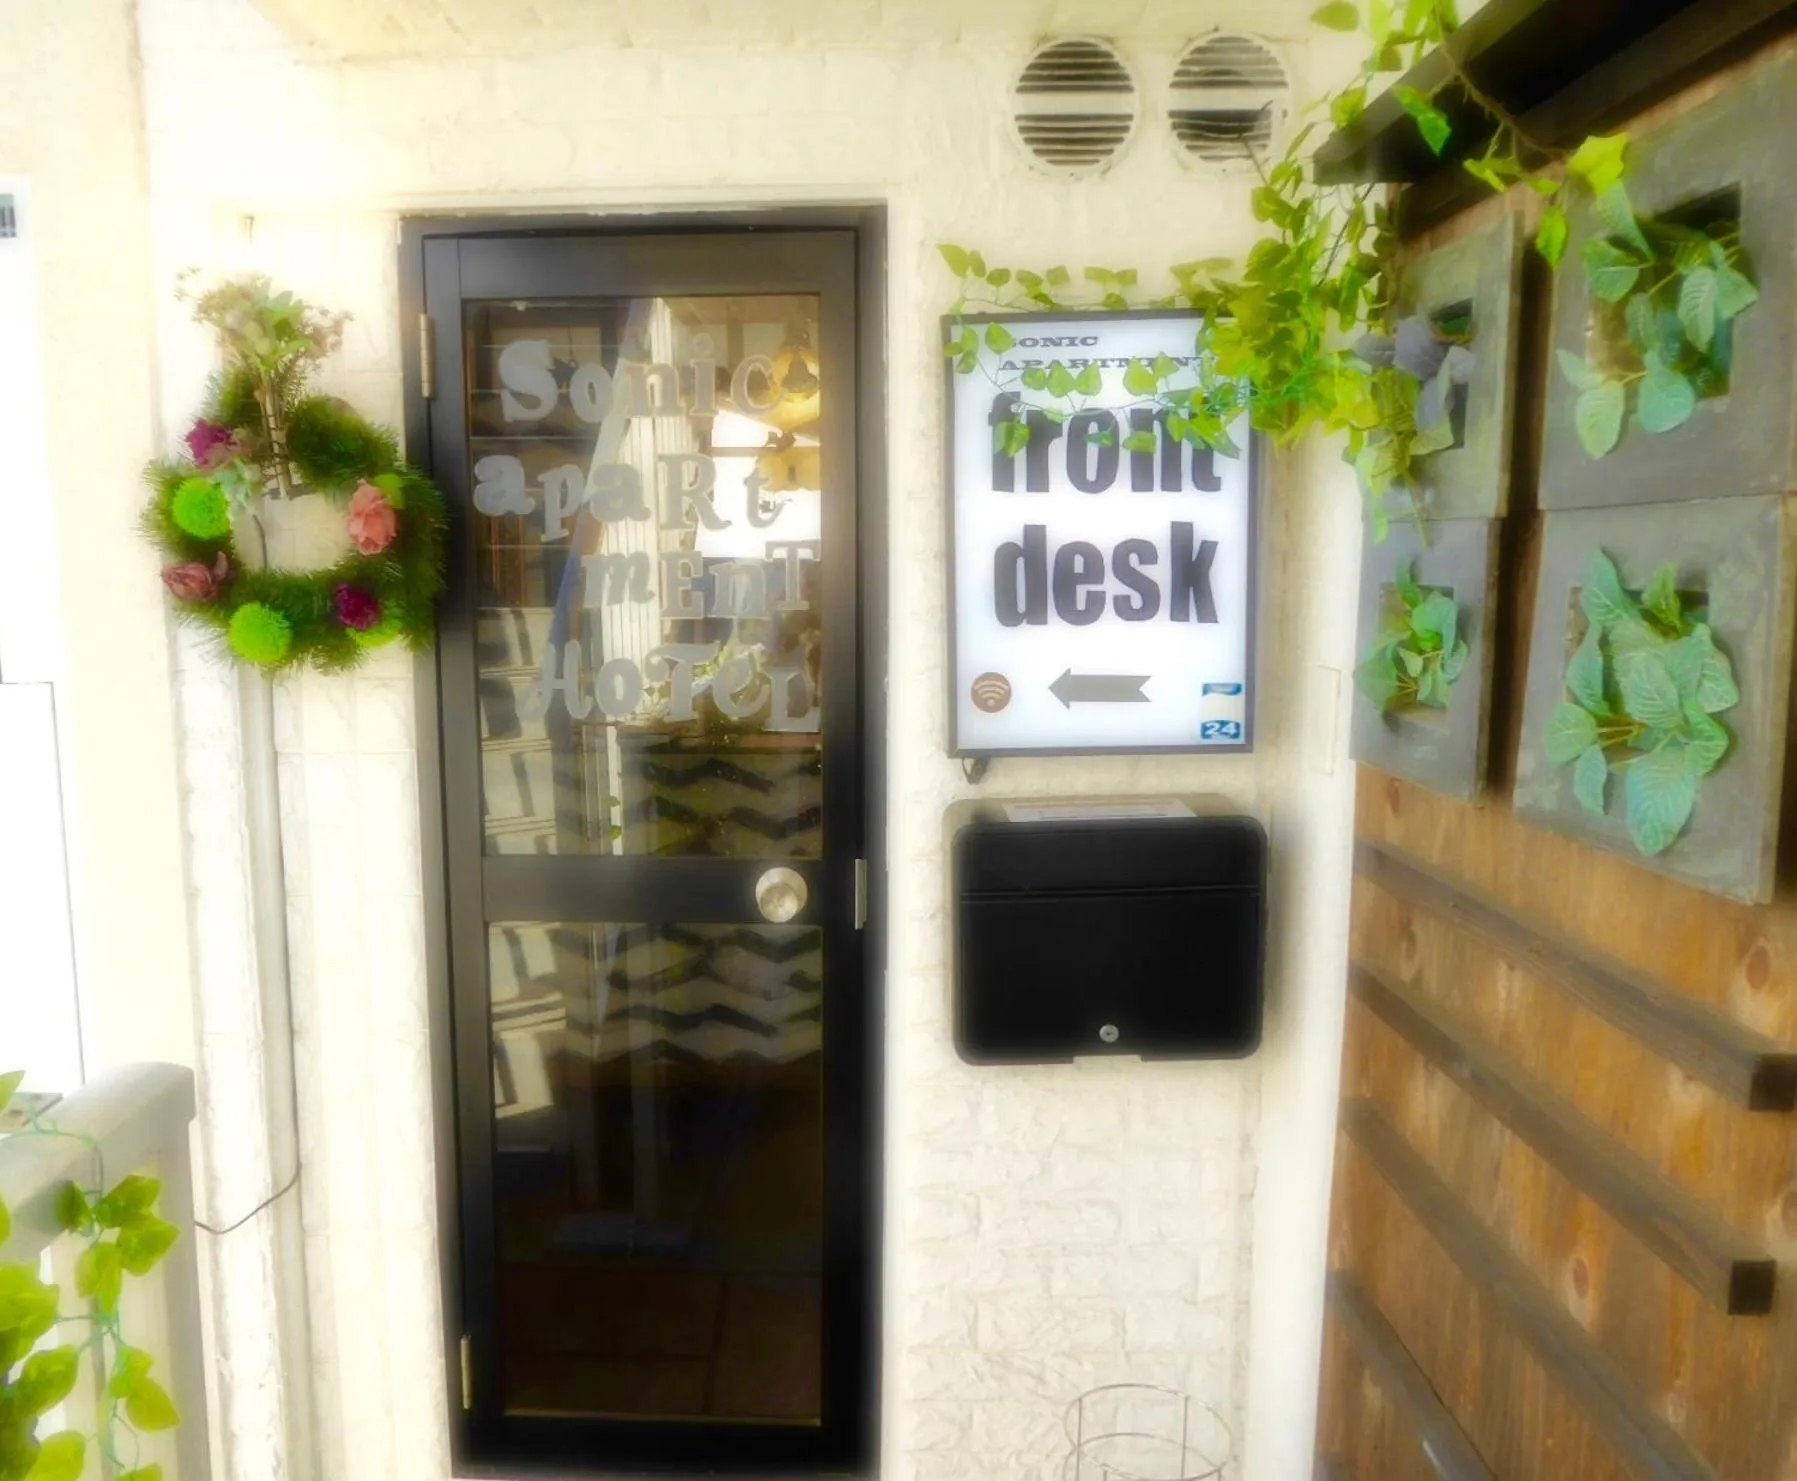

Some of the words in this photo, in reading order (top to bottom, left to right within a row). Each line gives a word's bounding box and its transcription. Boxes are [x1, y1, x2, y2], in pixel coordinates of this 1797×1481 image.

[499, 333, 785, 423] Sonic
[998, 356, 1217, 370] APARTMN
[1011, 336, 1098, 348] ONIC
[988, 391, 1222, 494] front
[994, 520, 1219, 627] desk
